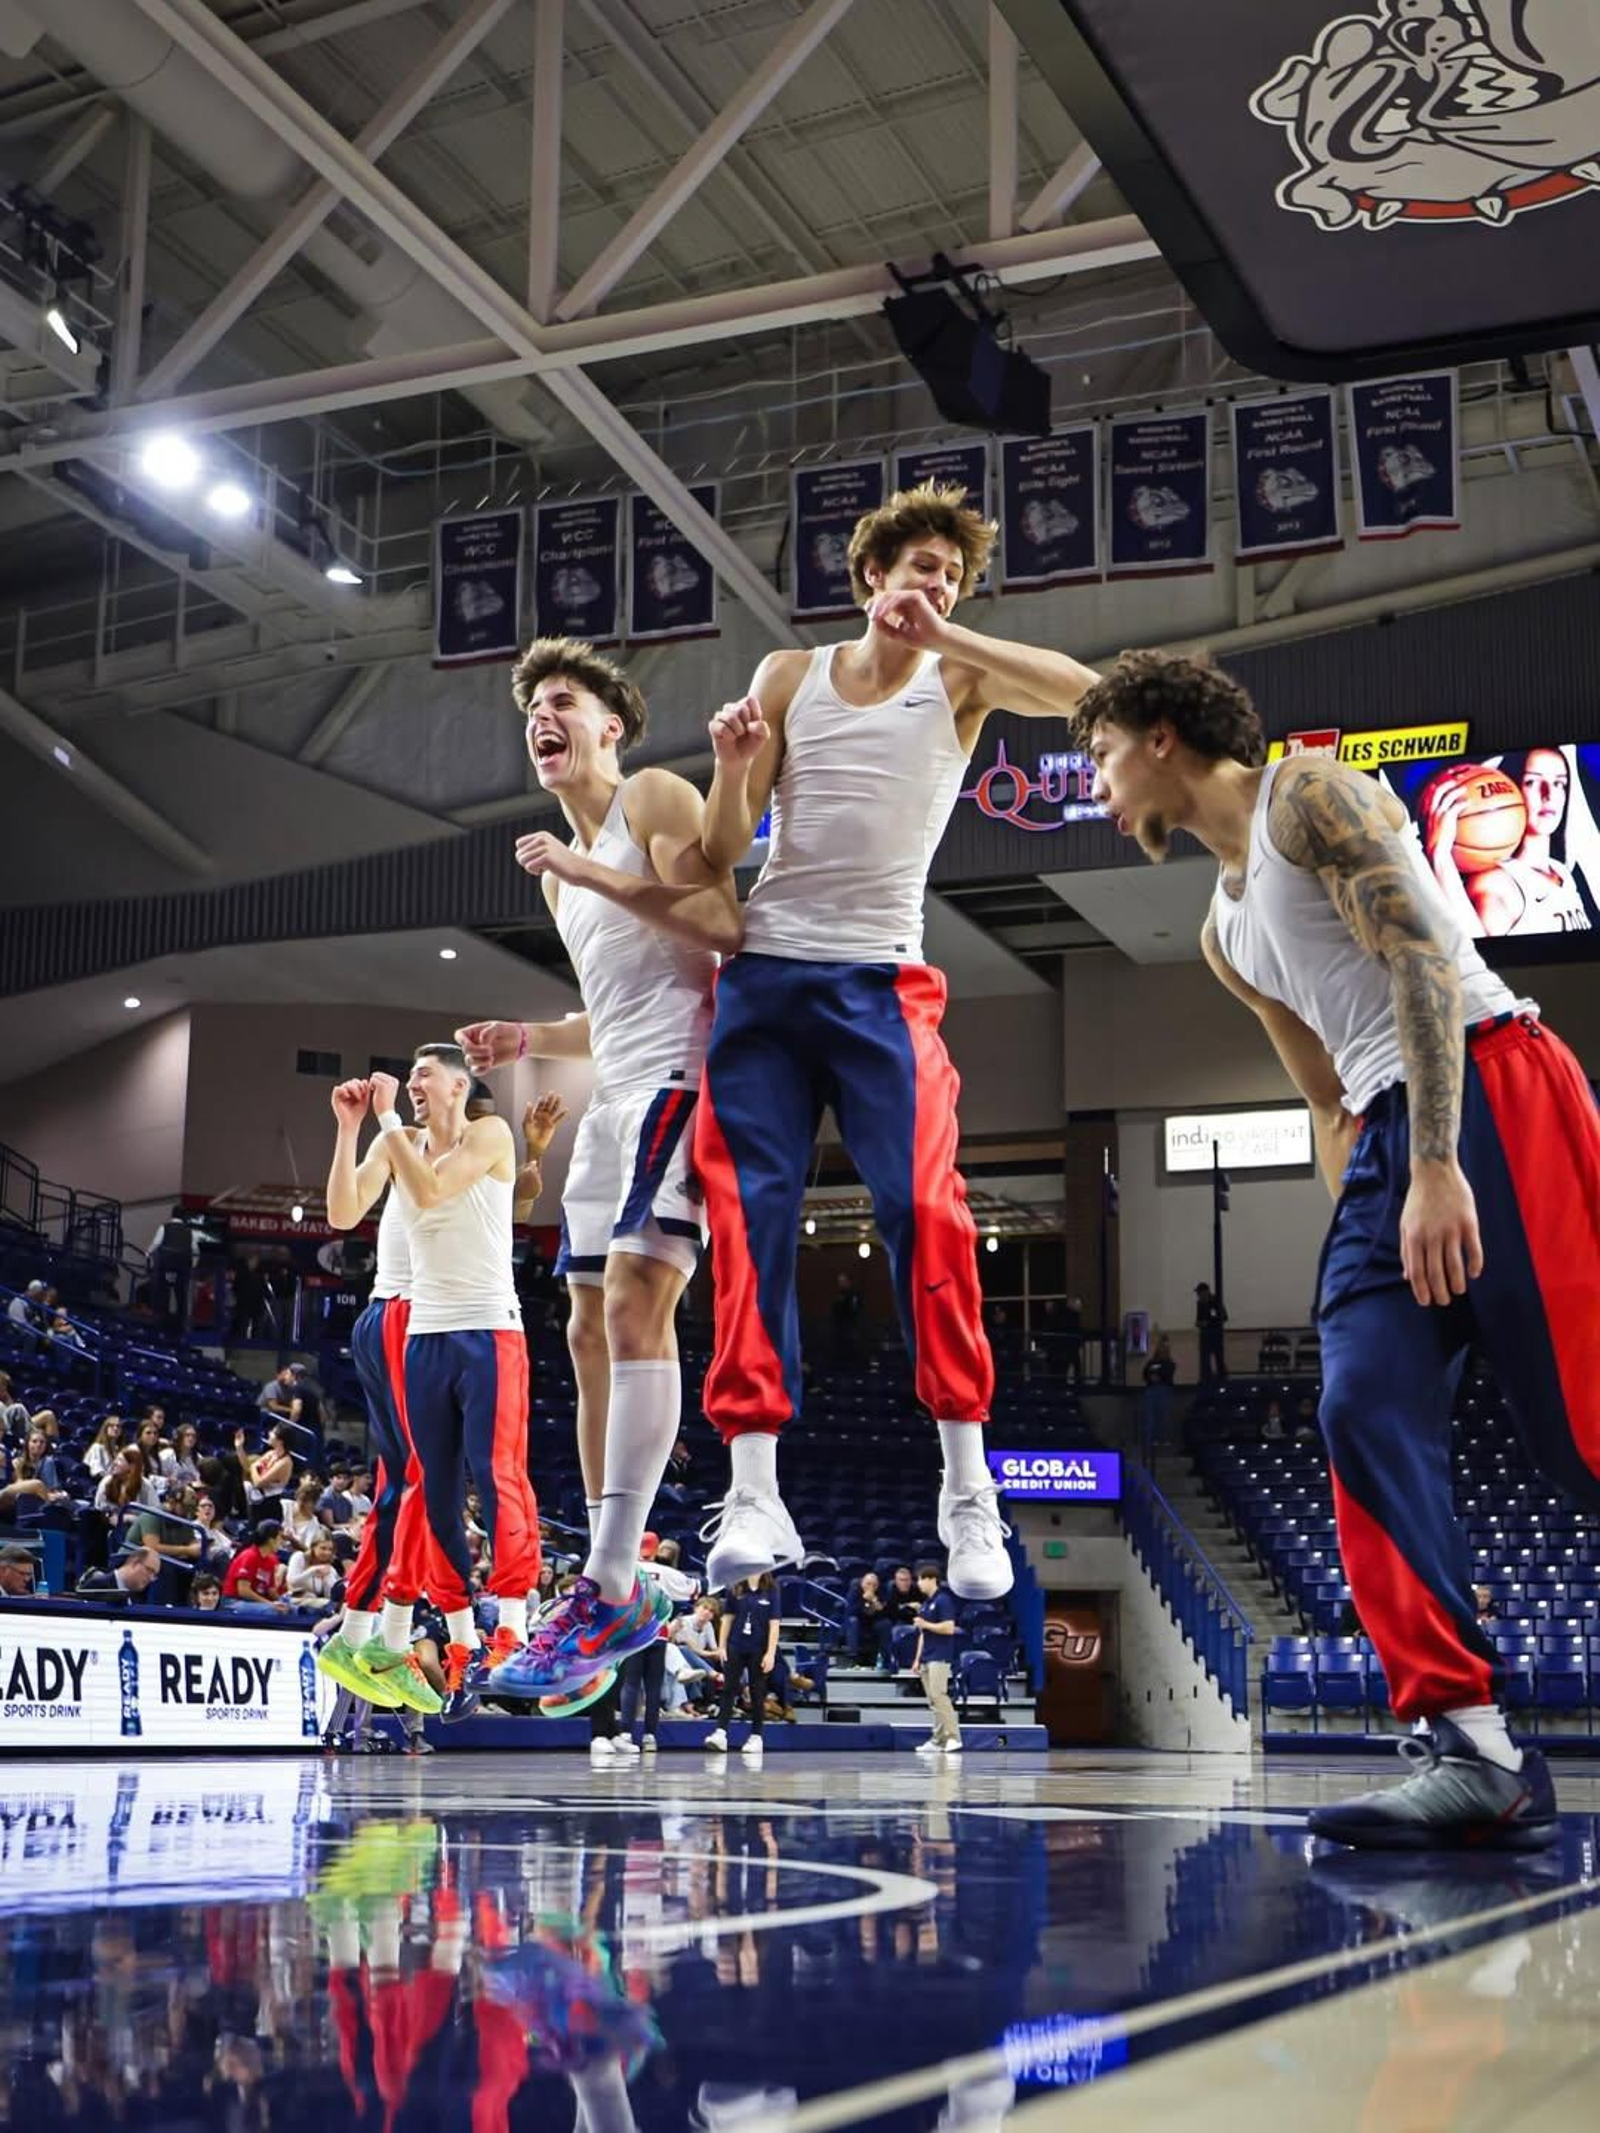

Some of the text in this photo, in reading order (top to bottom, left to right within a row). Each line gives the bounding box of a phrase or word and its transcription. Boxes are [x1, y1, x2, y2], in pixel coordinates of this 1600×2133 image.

[1385, 407, 1421, 420] NCAA
[1265, 429, 1304, 443] NCAA
[1342, 733, 1462, 762] LES SCHWAB
[230, 1215, 278, 1230] BAKED
[1002, 1459, 1097, 1478] GLOBAL
[1004, 1479, 1097, 1491] CREDIT UNION
[0, 1646, 89, 1702] ADY
[159, 1652, 274, 1706] READY
[3, 1704, 82, 1718] SPORTS DRINK
[205, 1707, 269, 1721] SPORTS DRINK
